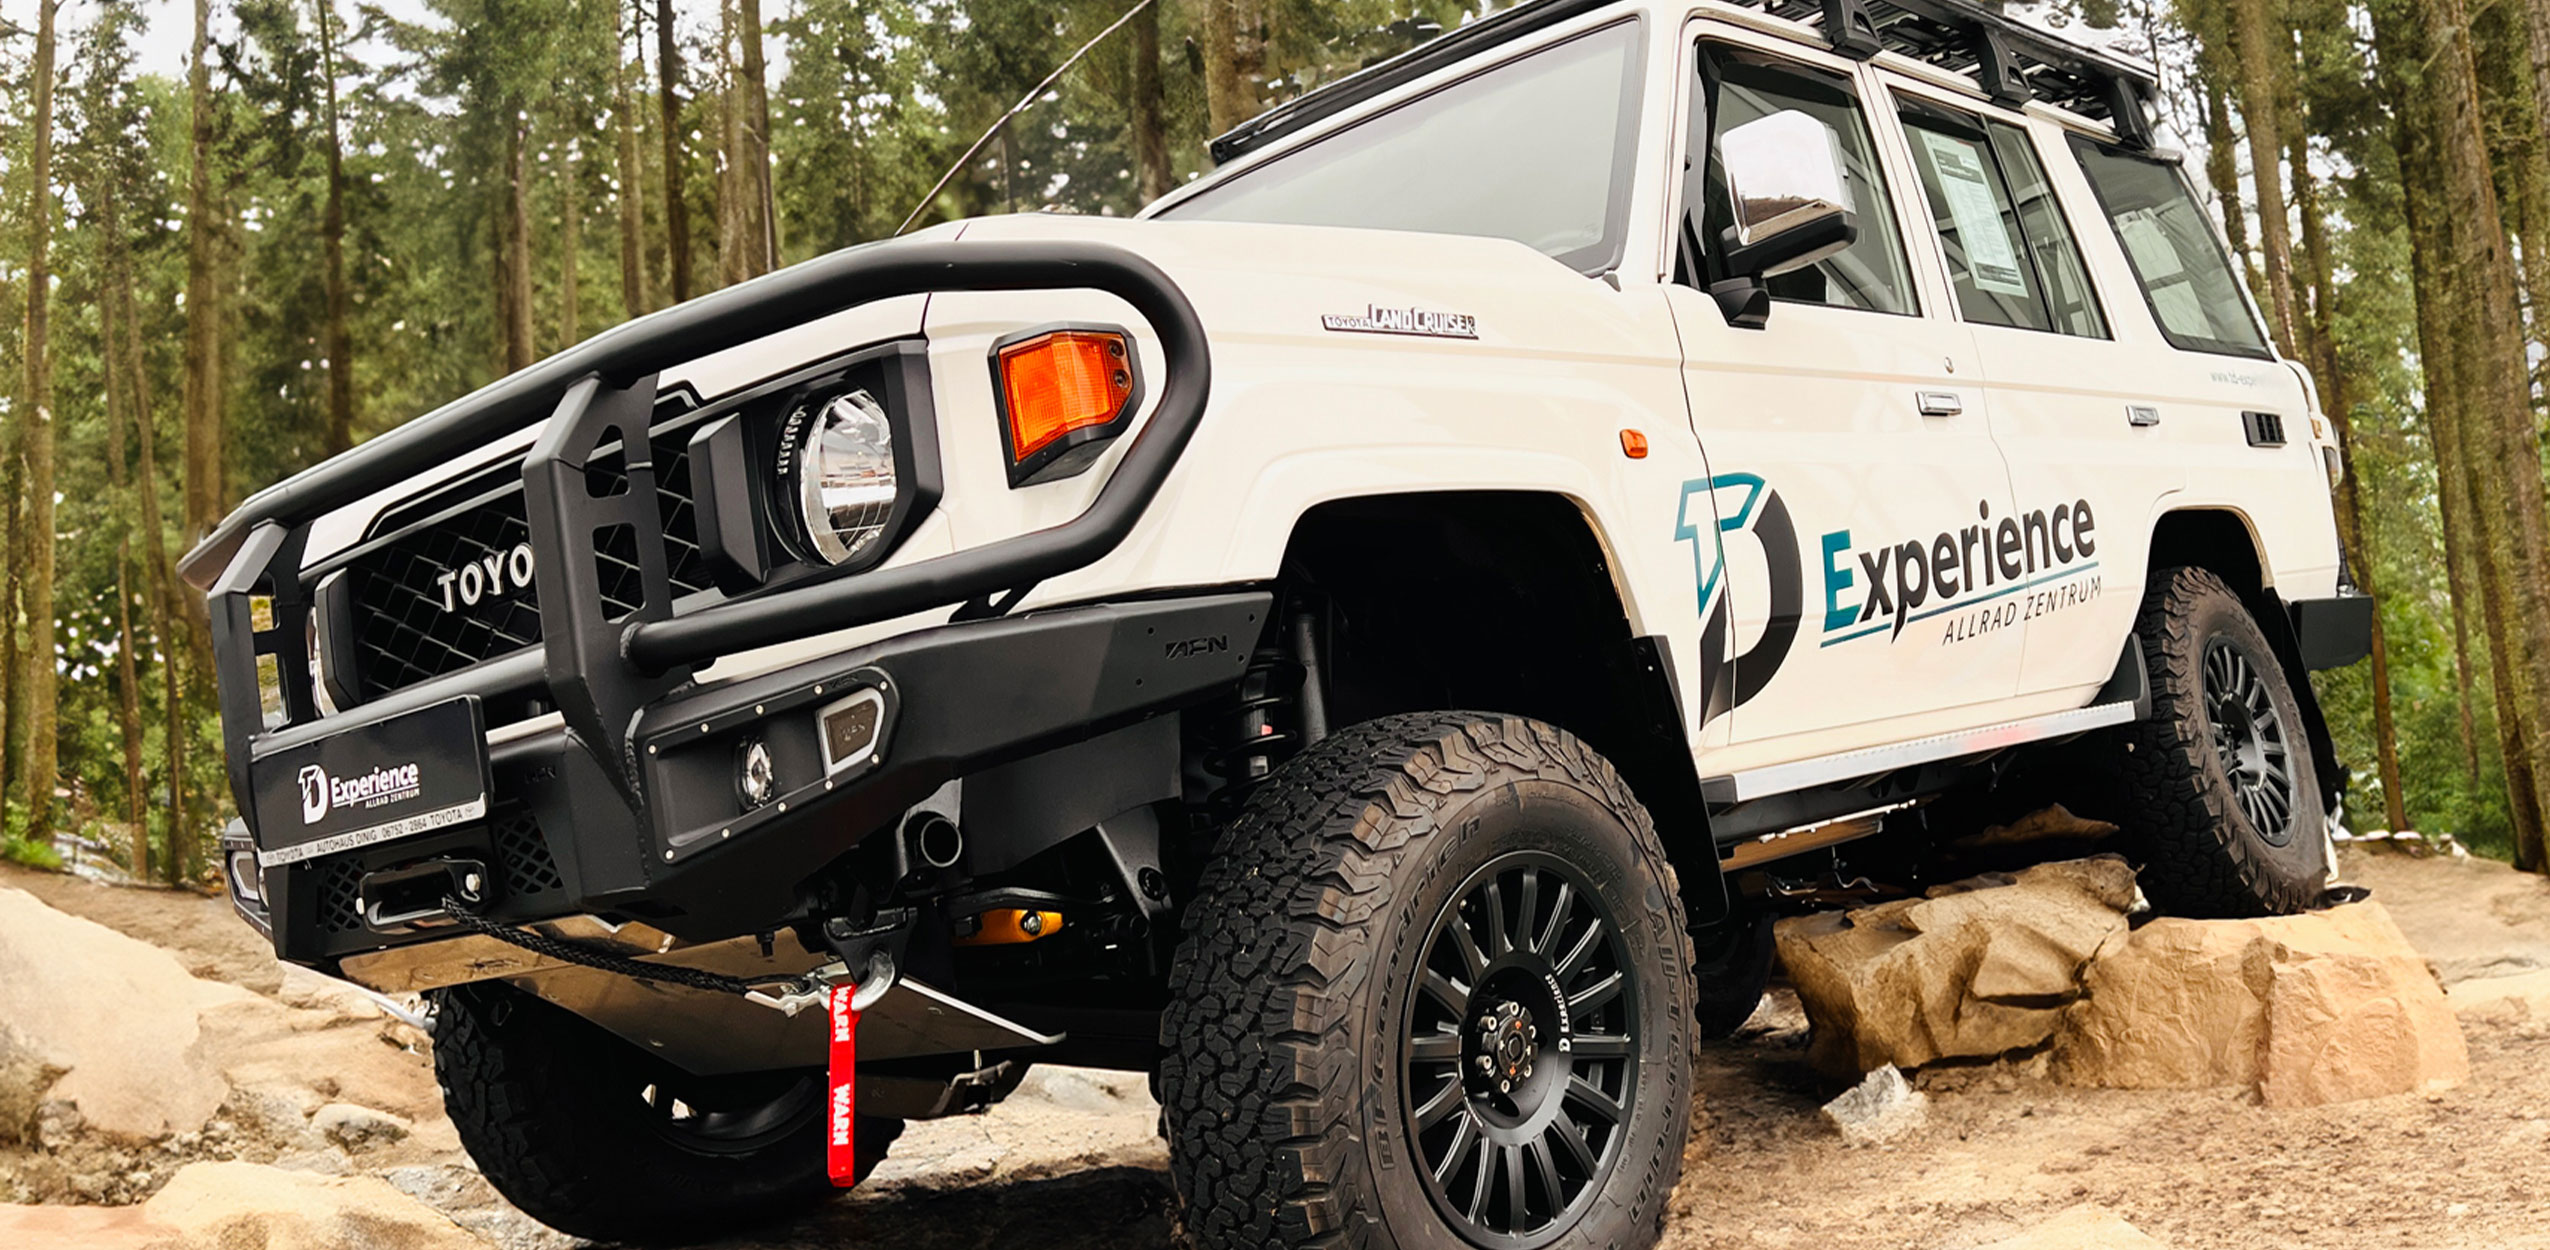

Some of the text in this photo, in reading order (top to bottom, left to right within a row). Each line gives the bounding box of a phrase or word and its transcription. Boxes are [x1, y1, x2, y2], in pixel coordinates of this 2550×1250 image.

[1328, 316, 1369, 328] TOYOTA
[437, 542, 534, 613] TOYO
[1821, 498, 2096, 644] Experience
[1942, 575, 2102, 646] ALLRAD ZENTRUM
[330, 762, 419, 807] Experience
[365, 788, 420, 809] ALLRAD ZENTRUM
[276, 847, 304, 863] TOYOTA
[316, 834, 355, 853] AUTOHAUS
[356, 830, 378, 845] DINIG
[381, 823, 404, 839] 06752
[410, 818, 428, 832] 2864
[429, 808, 463, 827] TOYOTA
[833, 986, 852, 1042] WARN
[1372, 814, 1482, 1170] BFGoodrich
[833, 1083, 851, 1146] WARN
